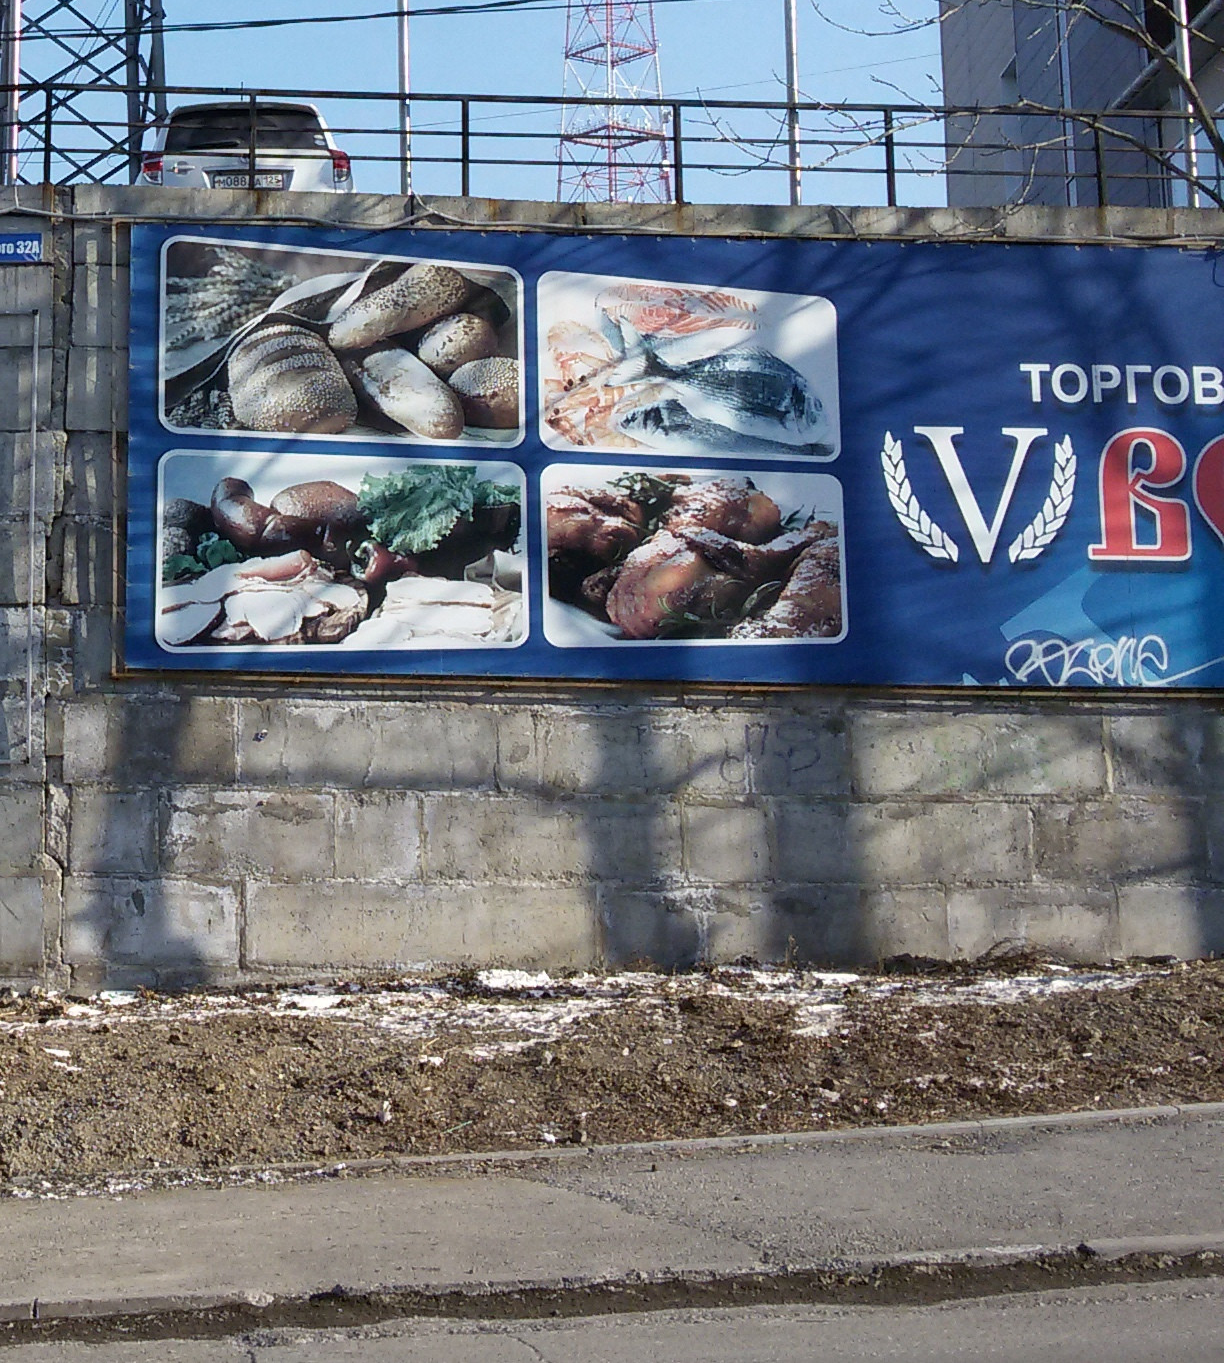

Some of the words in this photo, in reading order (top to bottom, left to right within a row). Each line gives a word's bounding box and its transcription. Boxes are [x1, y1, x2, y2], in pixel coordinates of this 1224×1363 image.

[16, 240, 40, 255] 32А
[1018, 363, 1224, 406] ТОРГОВ
[913, 426, 1048, 564] V
